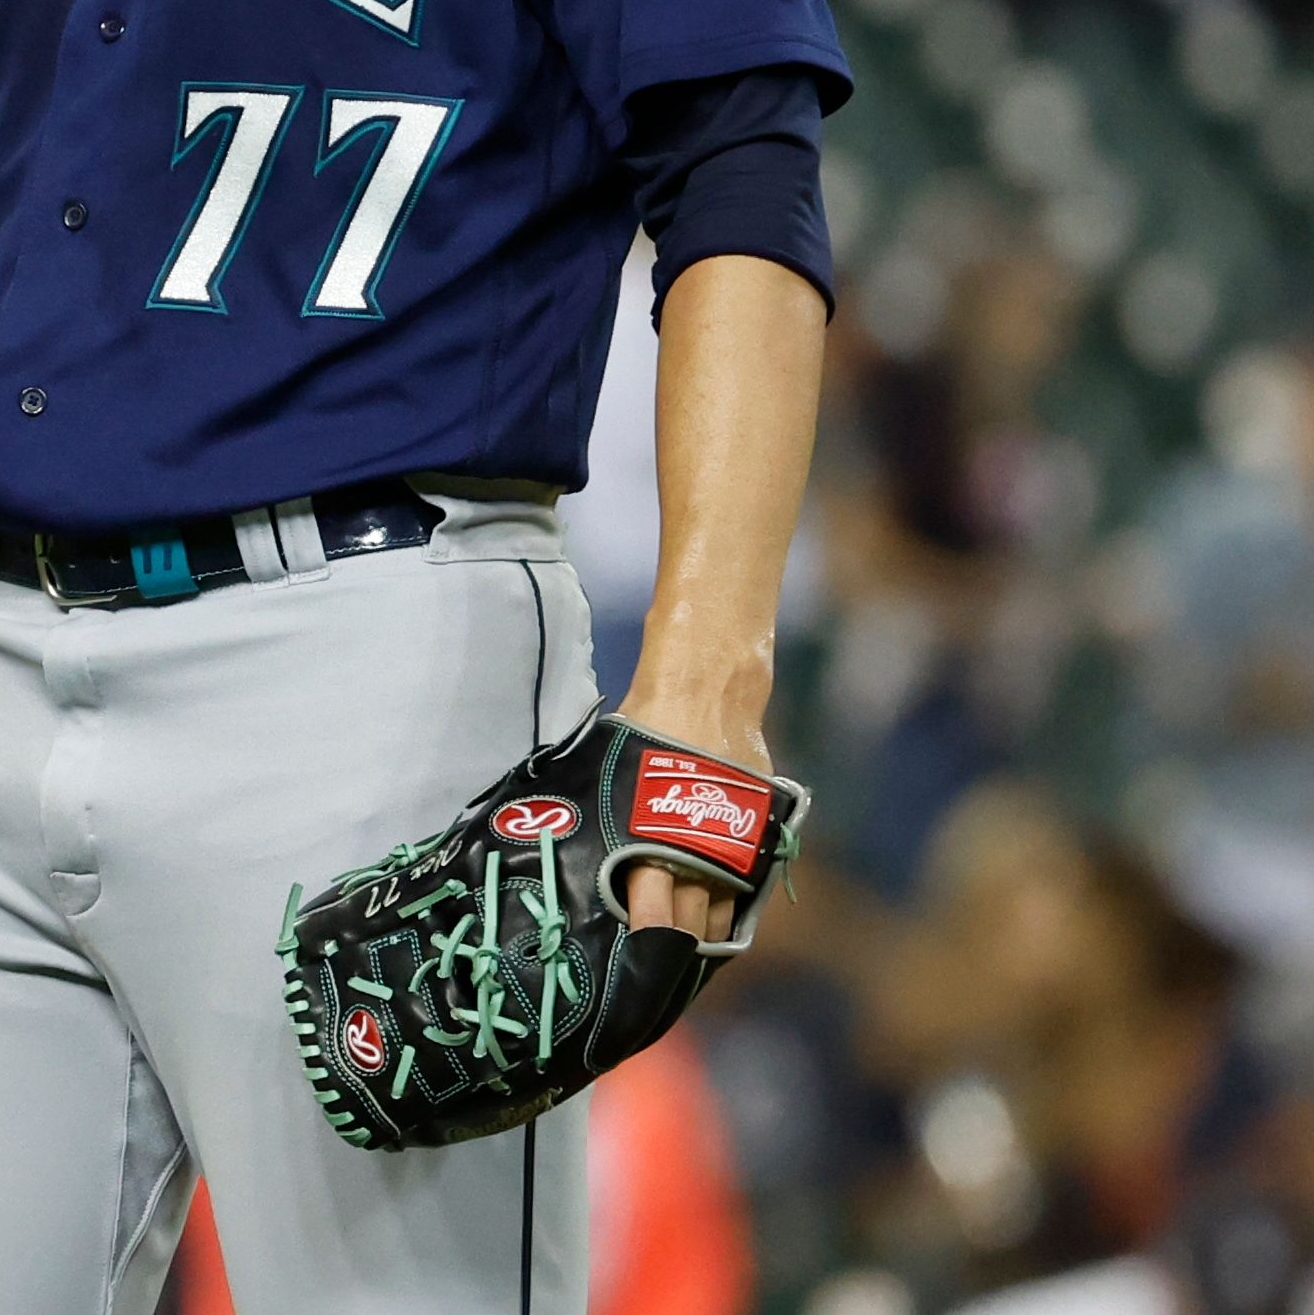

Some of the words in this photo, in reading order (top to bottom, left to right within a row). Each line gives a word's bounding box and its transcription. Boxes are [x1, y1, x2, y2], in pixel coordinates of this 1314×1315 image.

[144, 80, 466, 323] 77
[646, 783, 756, 839] Rawlings
[364, 876, 402, 919] 77
